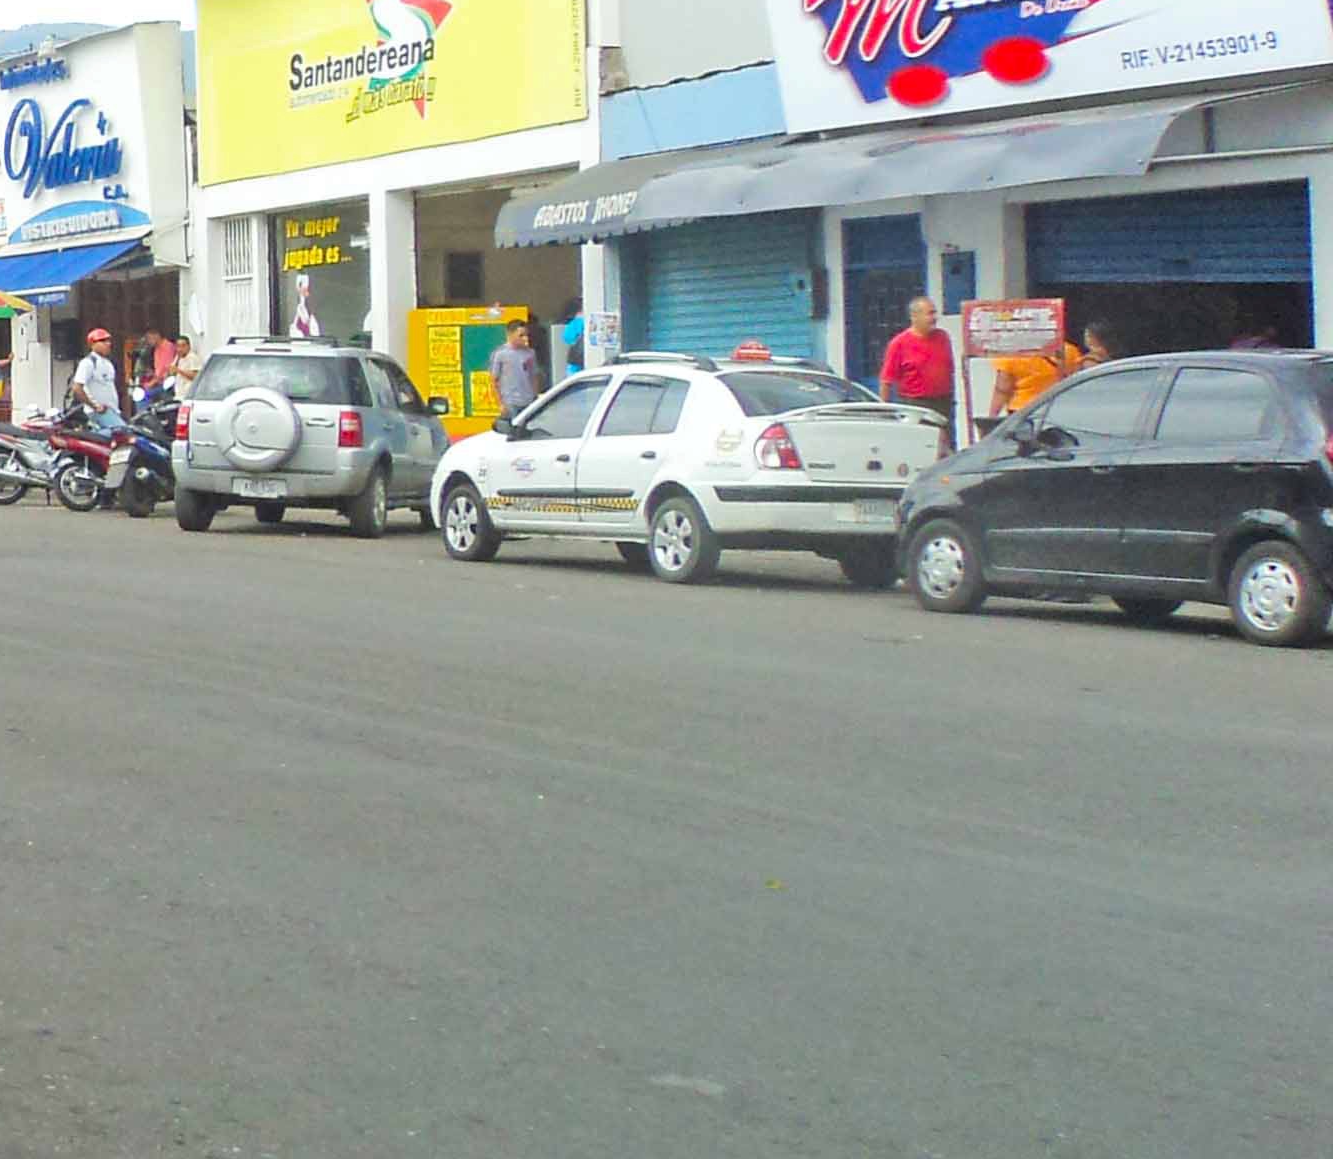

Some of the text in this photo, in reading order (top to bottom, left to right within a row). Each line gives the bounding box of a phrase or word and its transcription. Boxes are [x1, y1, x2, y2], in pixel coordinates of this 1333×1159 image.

[1155, 29, 1278, 66] V-21453901-9
[288, 36, 436, 91] Santandereana
[303, 215, 341, 239] mejor
[533, 199, 590, 230] ABASTOS
[282, 244, 323, 272] jugada
